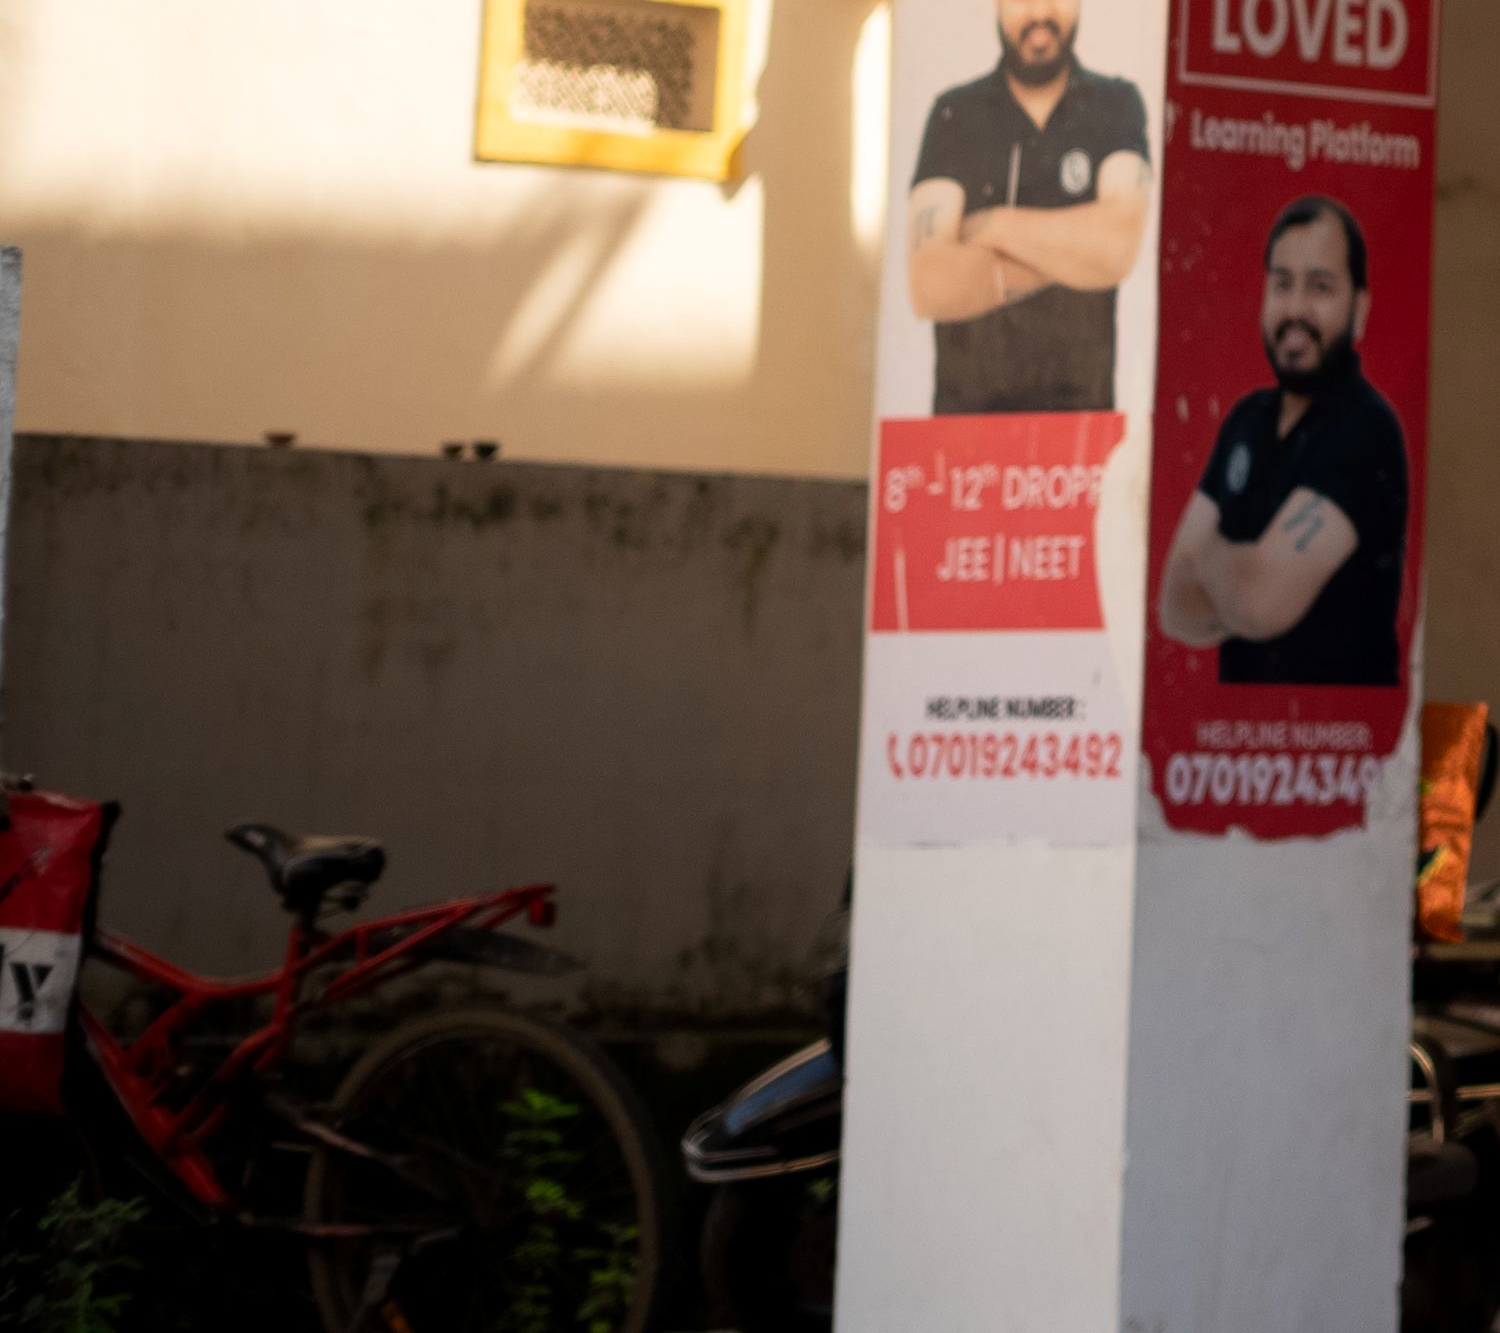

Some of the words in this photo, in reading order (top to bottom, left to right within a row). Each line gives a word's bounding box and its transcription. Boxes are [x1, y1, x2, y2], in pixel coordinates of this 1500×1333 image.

[1189, 105, 1307, 173] Learning
[1308, 116, 1422, 171] Platform
[934, 535, 991, 583] JEE
[1007, 534, 1086, 582] NEET
[906, 731, 1124, 780] 07019243492
